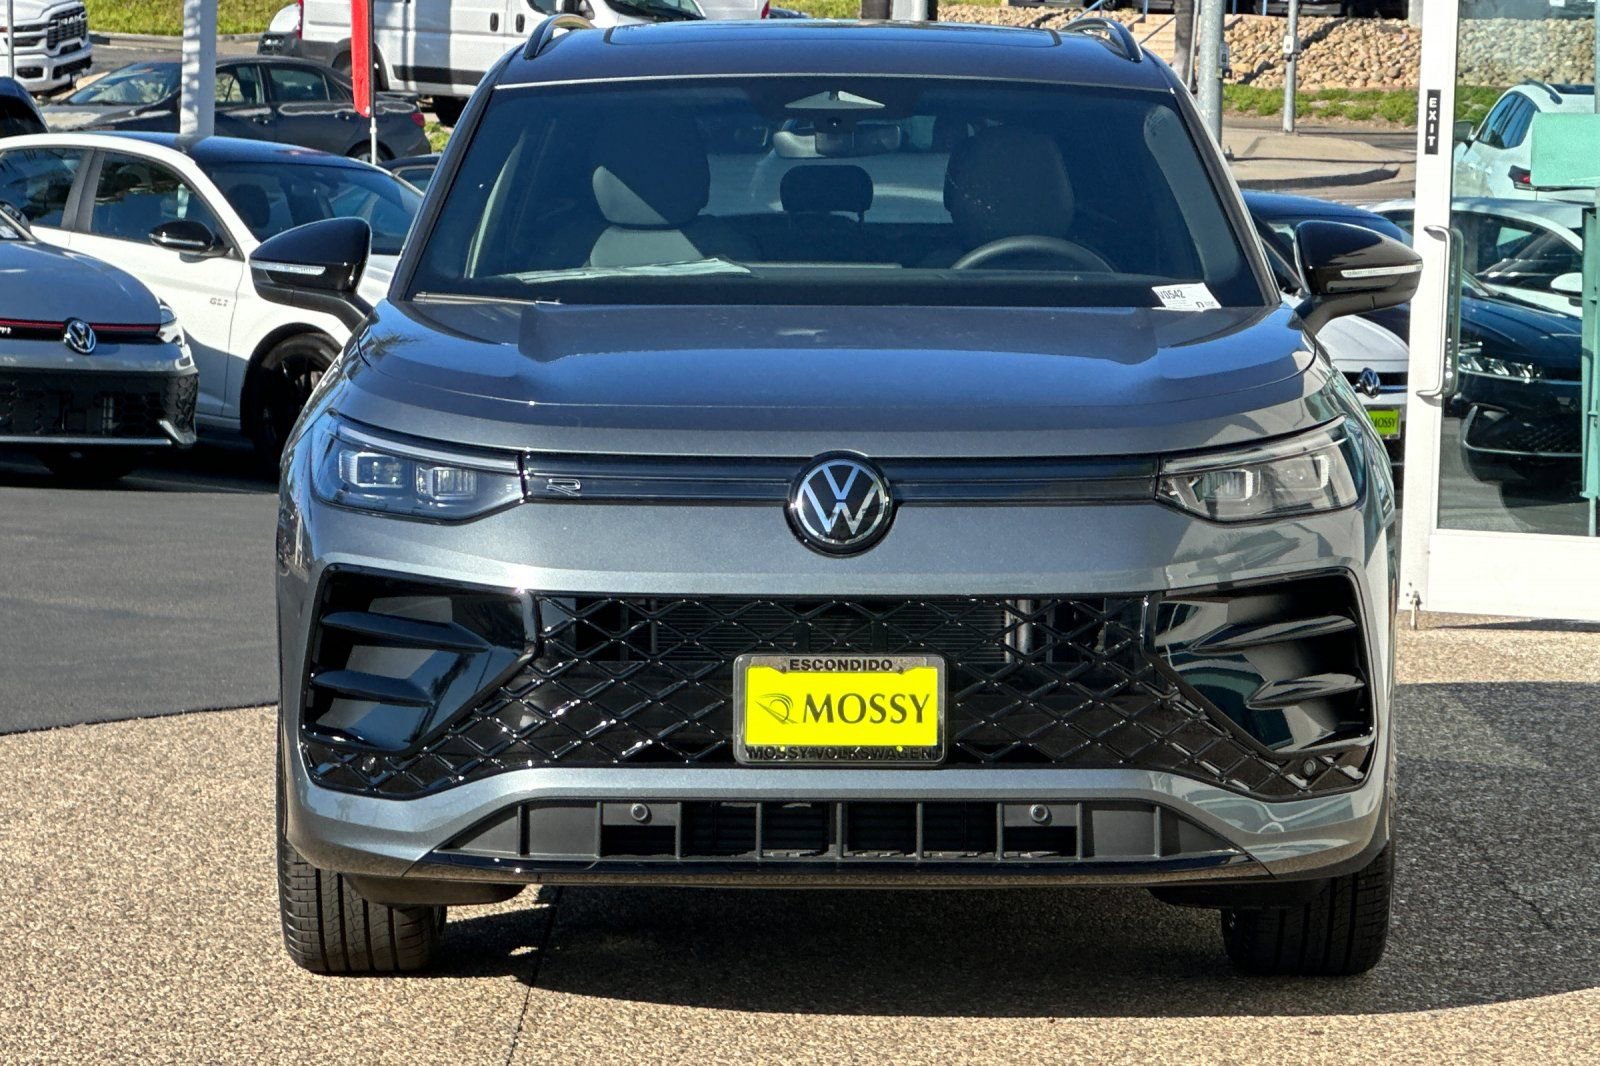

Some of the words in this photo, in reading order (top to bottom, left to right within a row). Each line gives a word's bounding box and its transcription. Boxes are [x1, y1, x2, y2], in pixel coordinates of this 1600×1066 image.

[1427, 97, 1438, 147] EXIT
[799, 461, 883, 541] VW
[789, 659, 893, 671] ESCONDIDO
[802, 693, 931, 724] MOSSY
[748, 746, 806, 760] MOSSY
[814, 746, 933, 760] VOLKSWAGEN
